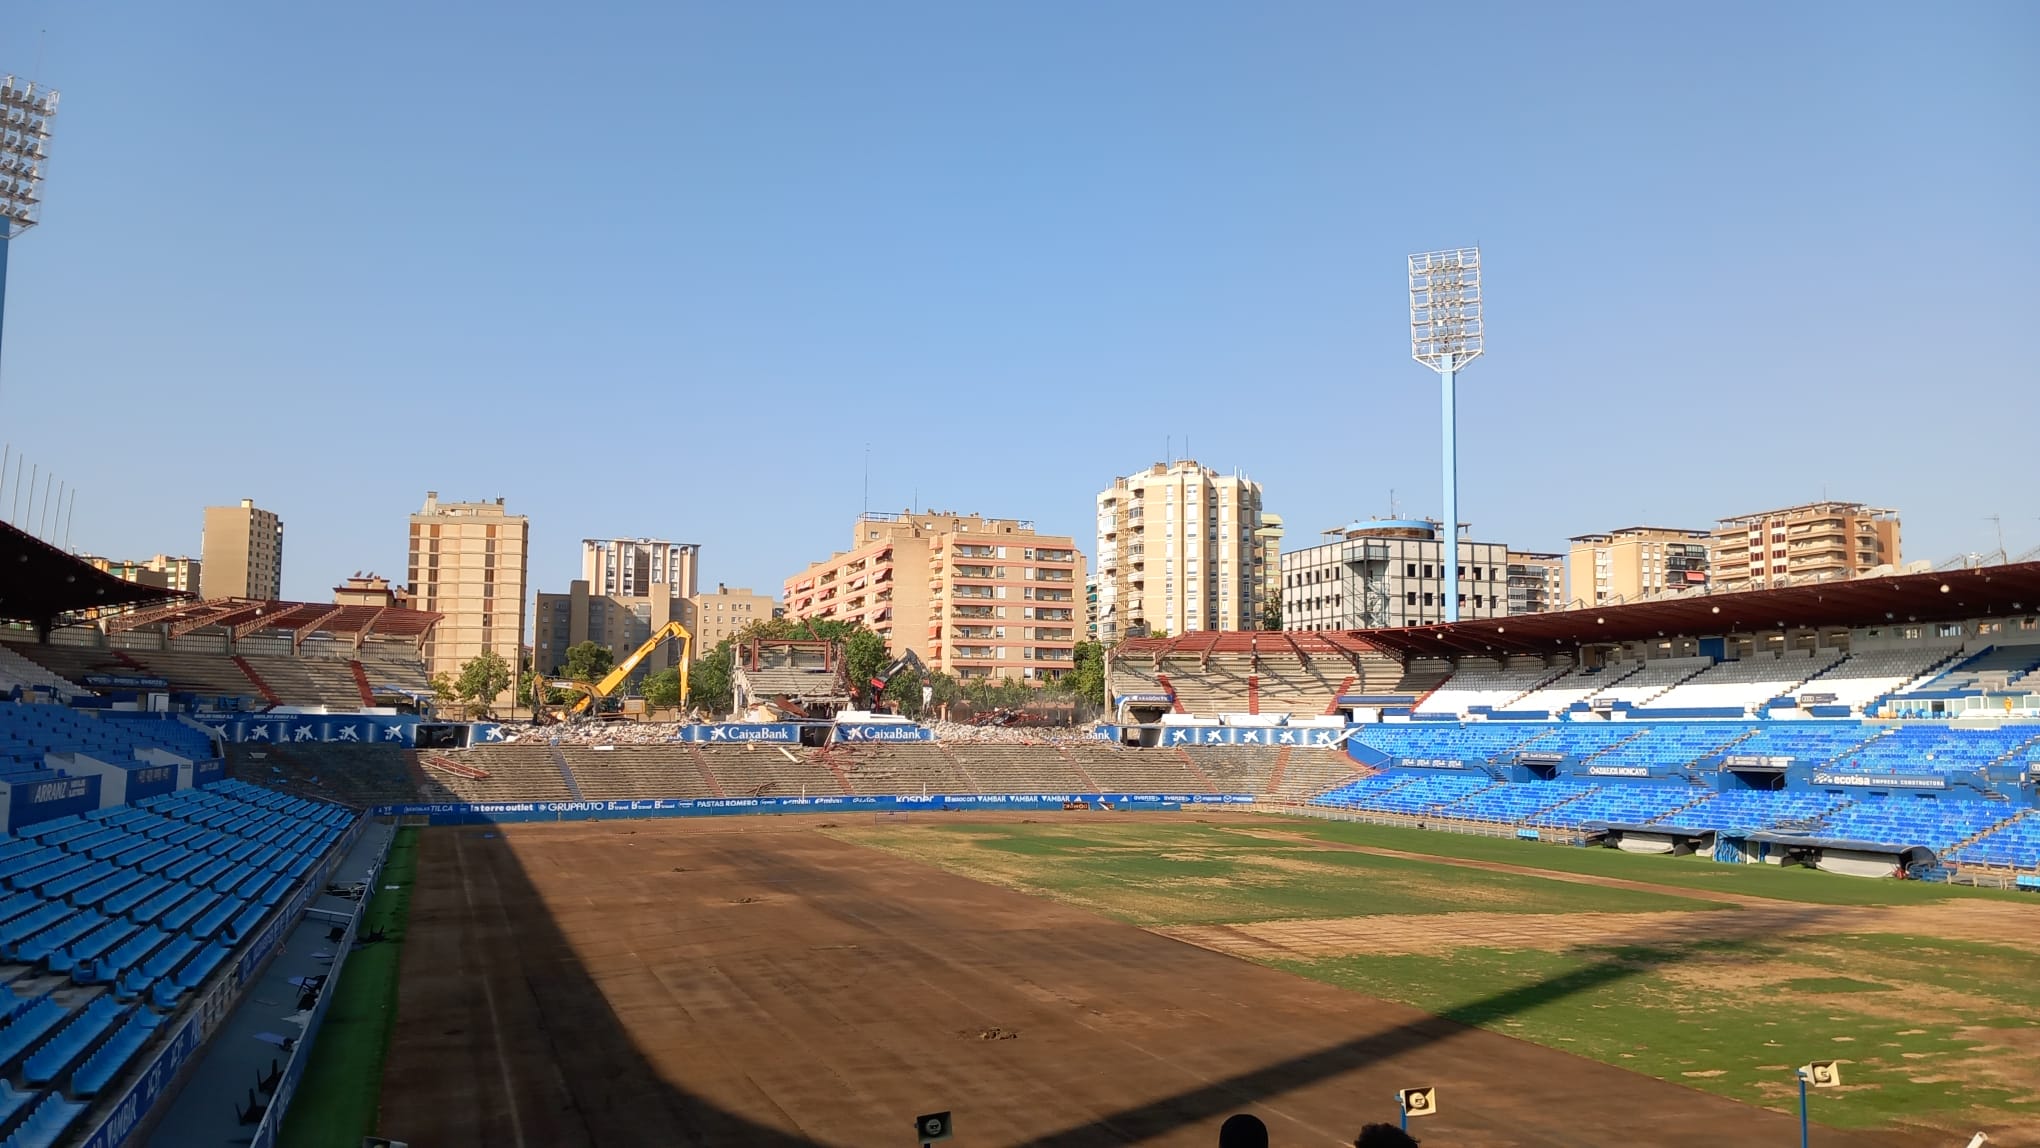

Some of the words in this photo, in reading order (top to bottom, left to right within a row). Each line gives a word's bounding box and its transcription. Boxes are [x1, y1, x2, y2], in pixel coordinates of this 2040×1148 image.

[728, 726, 789, 740] CaixaBank
[864, 726, 921, 740] CaixaBank
[1619, 767, 1647, 776] MONCAYO
[1833, 774, 1870, 785] ecotisa
[34, 782, 67, 803] ARRANZ
[480, 804, 506, 812] torre
[505, 803, 533, 812] outlet
[547, 802, 604, 812] GRUPAUTO
